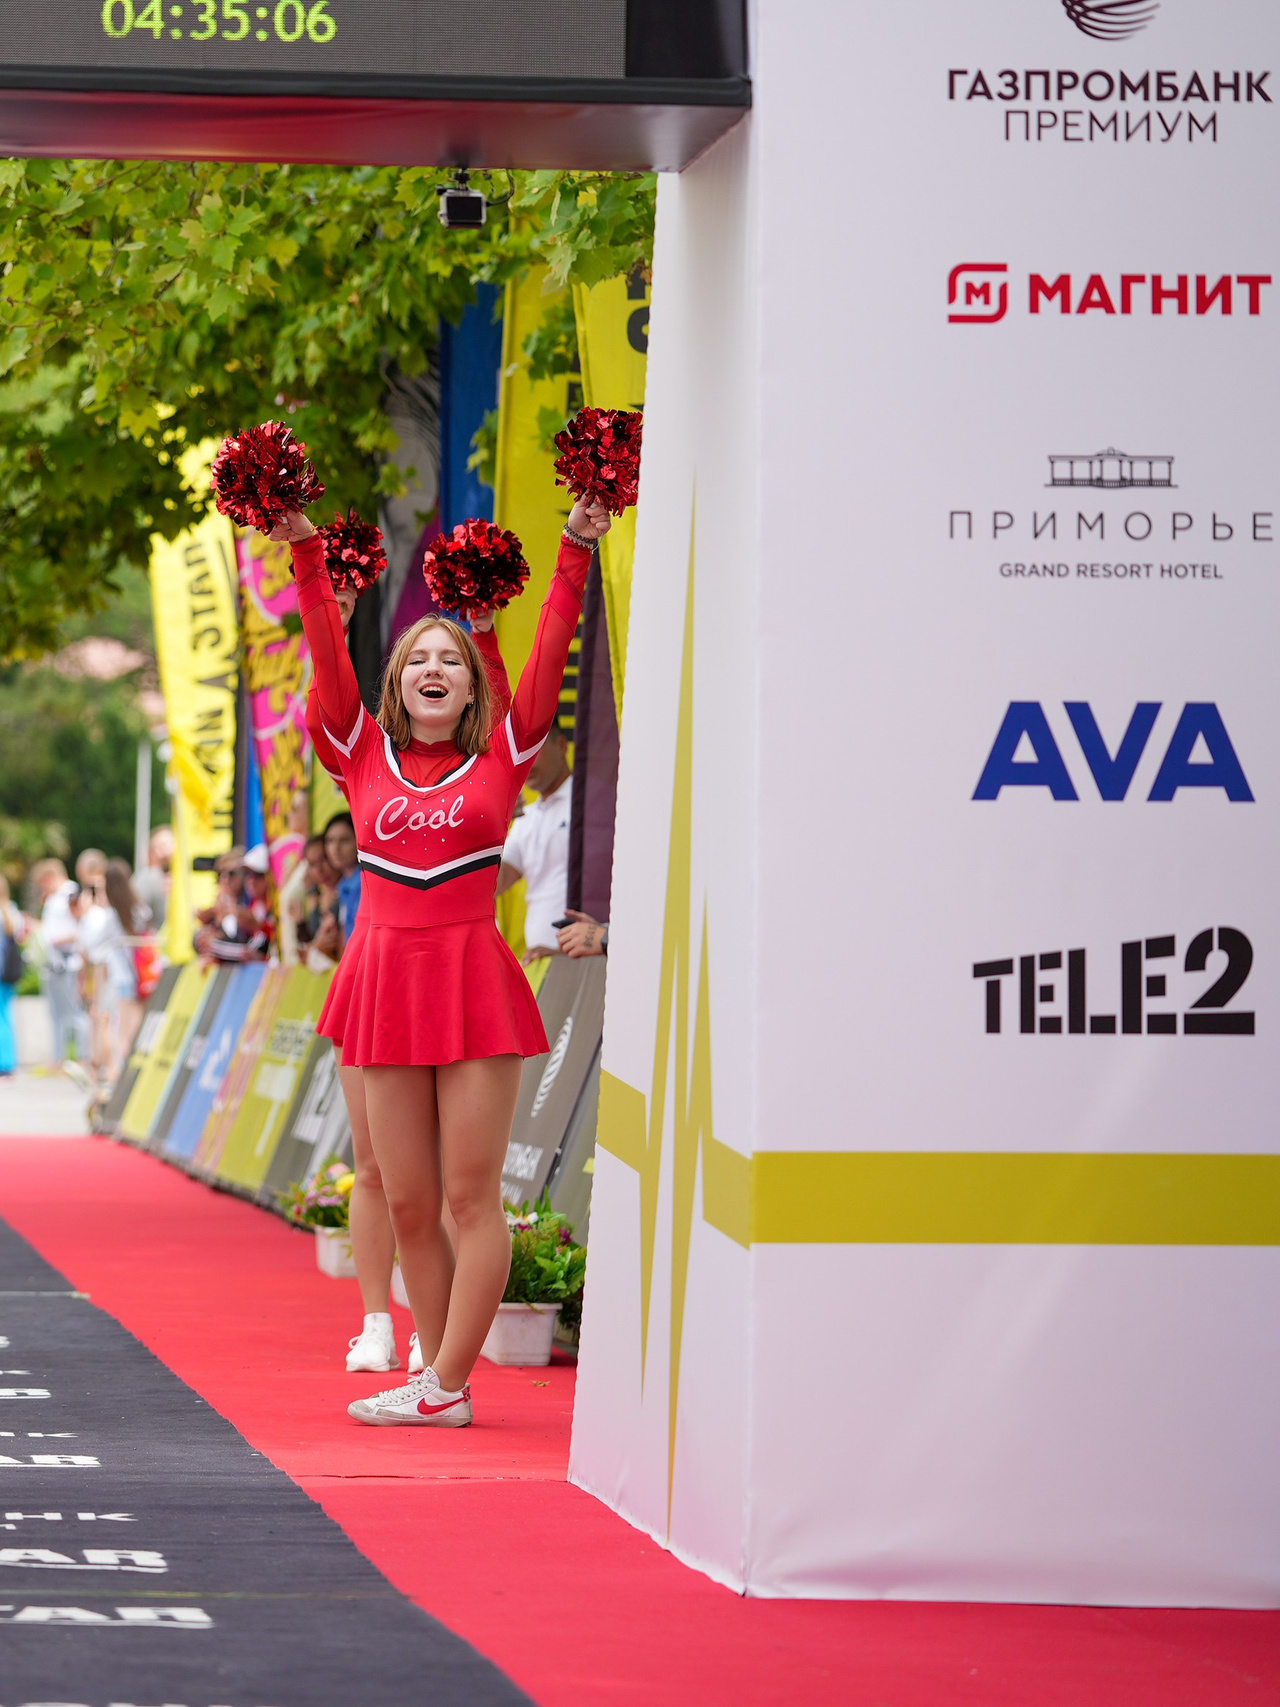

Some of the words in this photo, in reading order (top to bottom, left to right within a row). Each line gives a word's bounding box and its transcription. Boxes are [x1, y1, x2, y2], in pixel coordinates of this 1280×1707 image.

[101, 0, 337, 43] 04:35:06
[948, 69, 1273, 103] ГАЗПРОМБАНК
[1005, 110, 1217, 143] ПРЕМИУМ
[1029, 273, 1272, 316] МАГНИТ
[949, 511, 1273, 541] ПРИМОРЬЕ
[999, 562, 1069, 578] GRAND
[1076, 563, 1154, 579] RESORT
[1160, 564, 1223, 579] HOTEL
[971, 701, 1256, 802] AVA
[375, 795, 464, 840] Cool
[973, 926, 1255, 1035] TELE2
